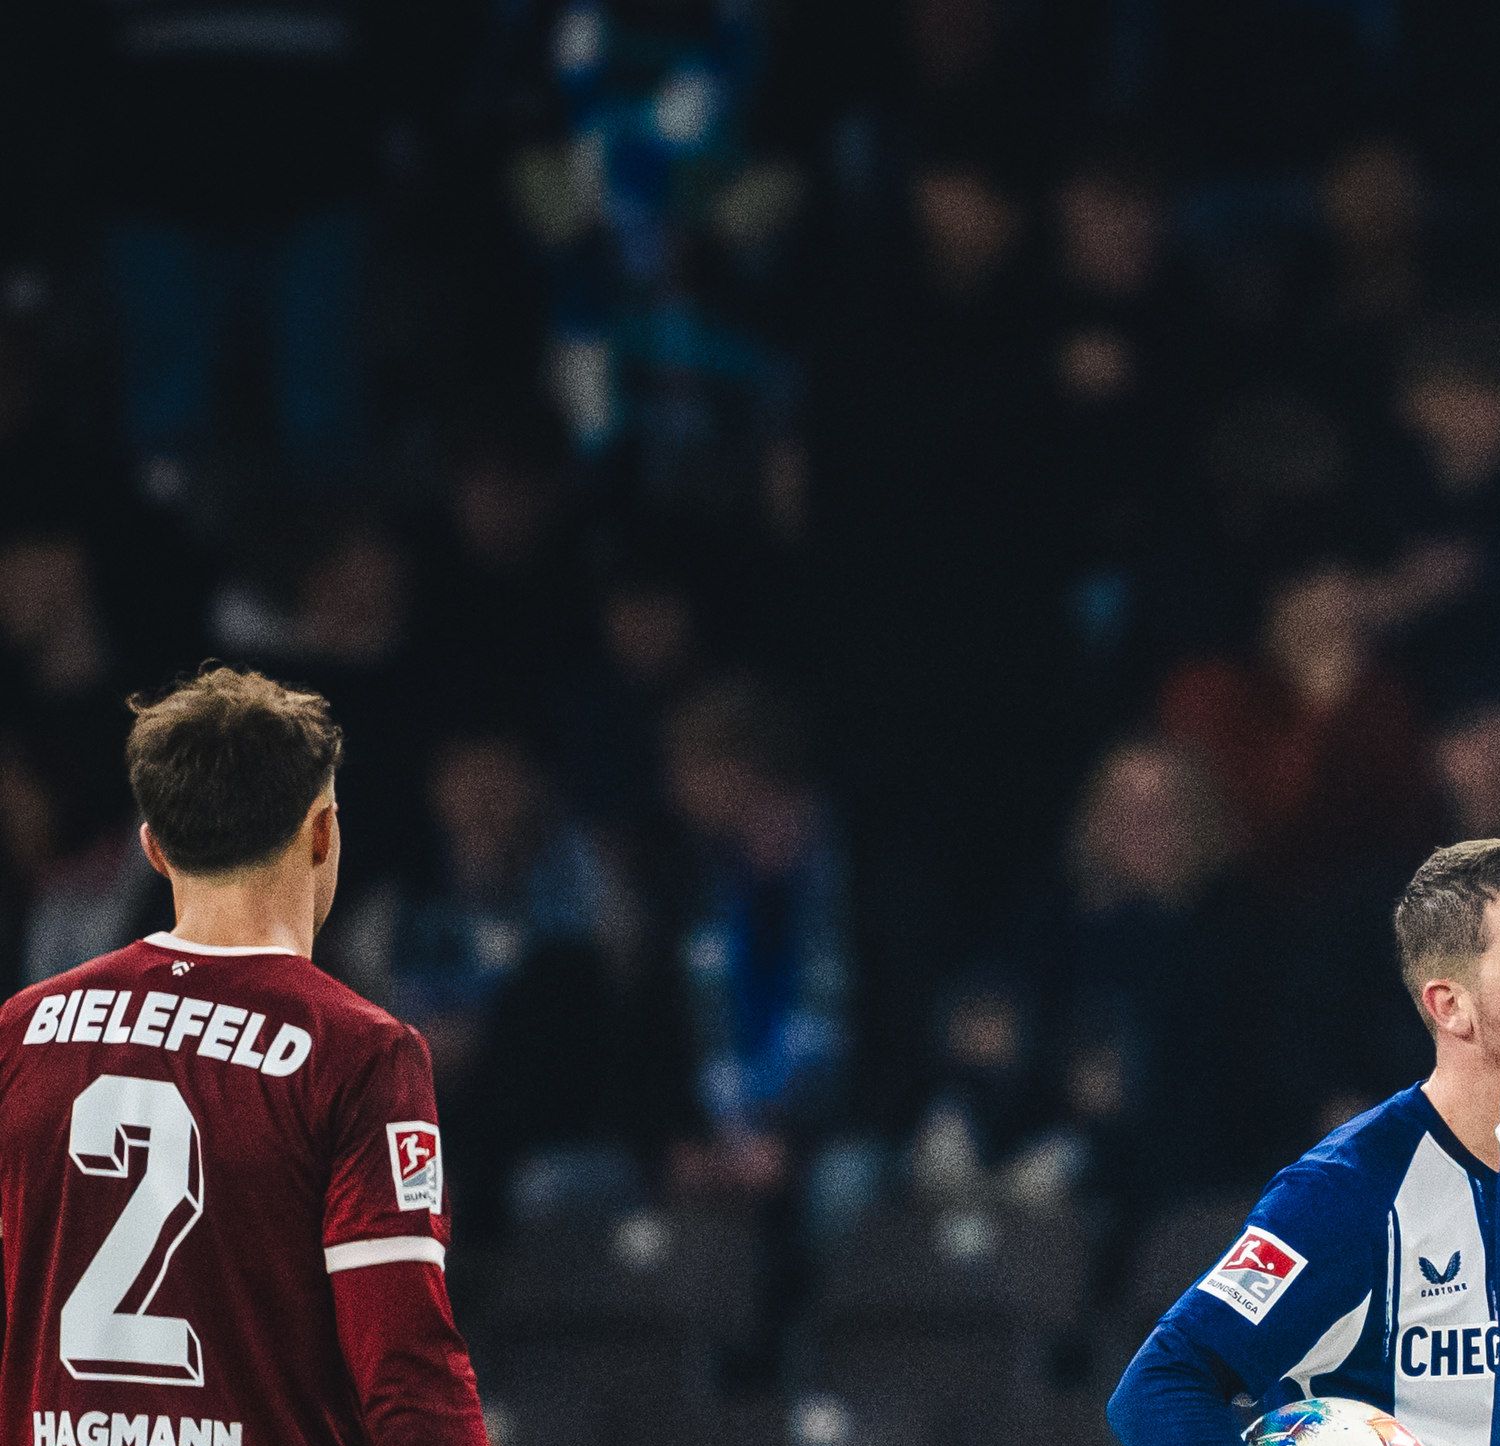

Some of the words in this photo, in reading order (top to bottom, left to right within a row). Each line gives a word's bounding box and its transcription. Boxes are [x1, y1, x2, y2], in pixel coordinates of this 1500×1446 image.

[23, 988, 312, 1077] BIELEFELD
[60, 1073, 204, 1387] 2
[1206, 1278, 1259, 1315] BUNDESLIGA
[1421, 1282, 1468, 1298] CASTORE
